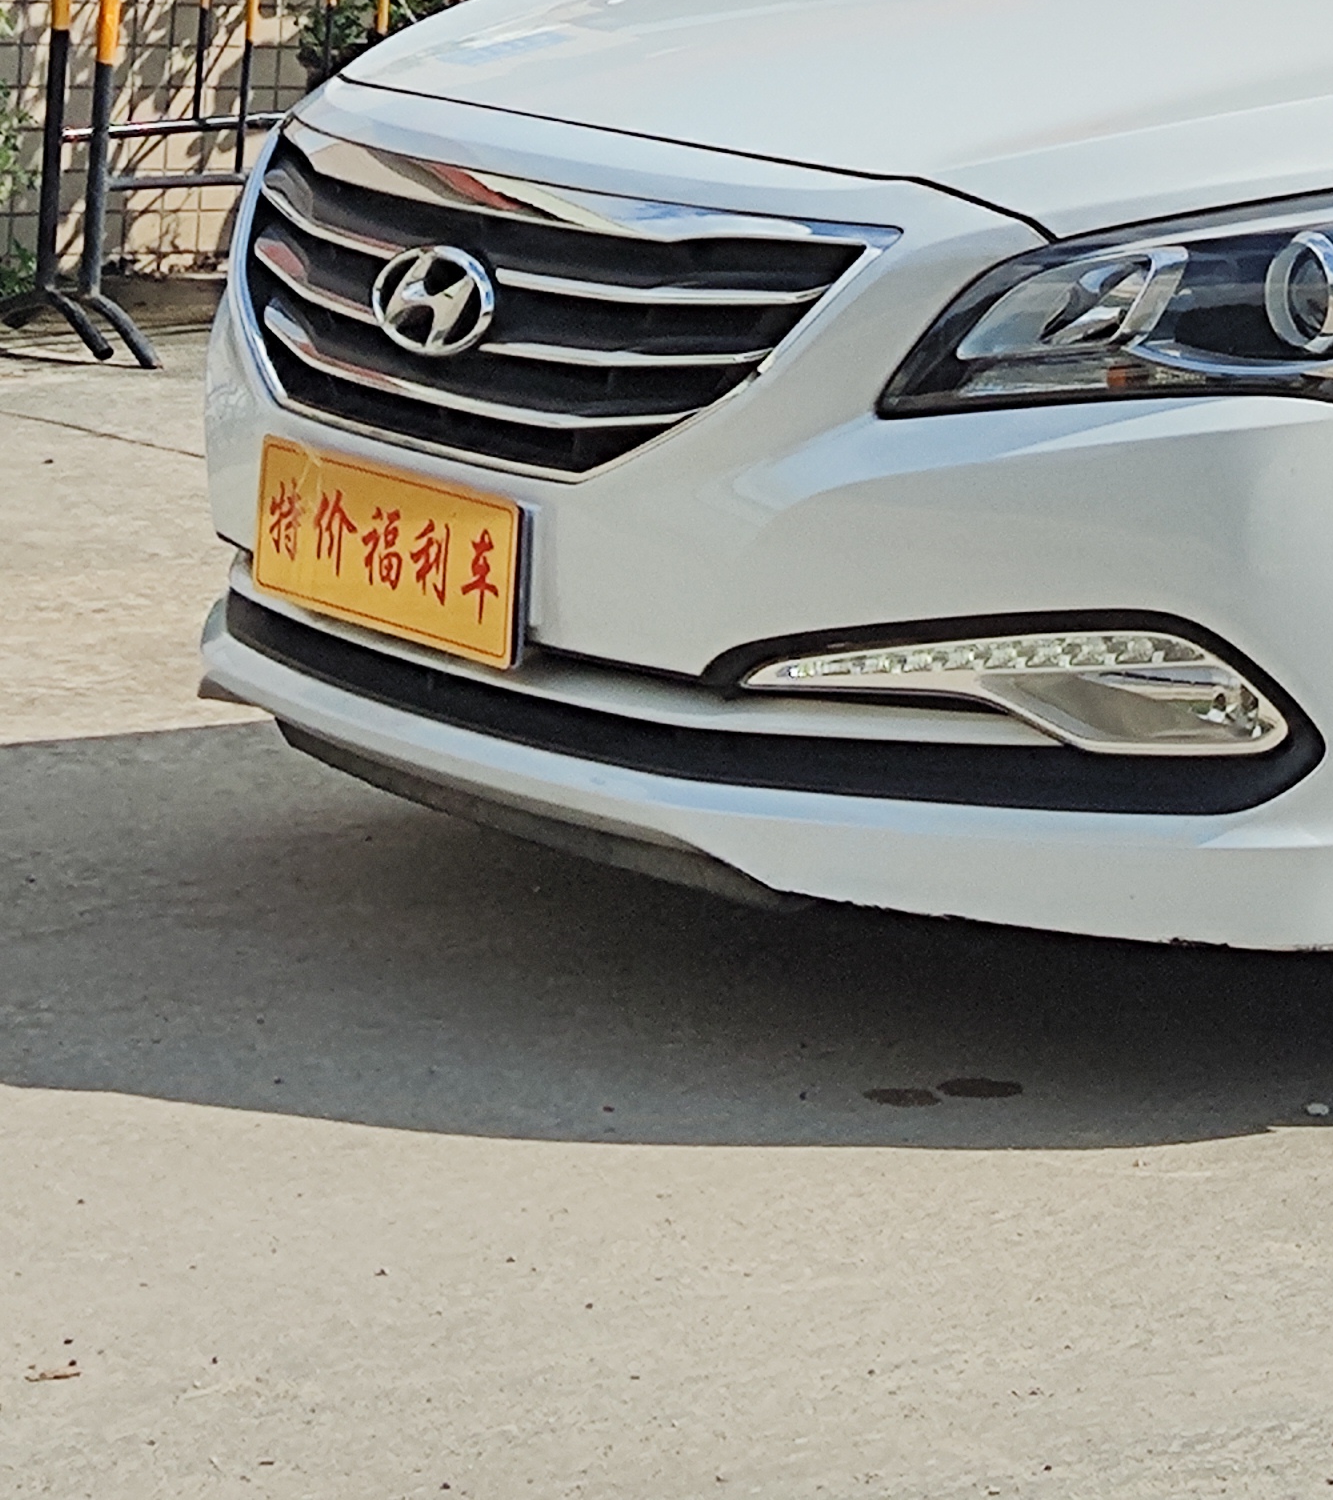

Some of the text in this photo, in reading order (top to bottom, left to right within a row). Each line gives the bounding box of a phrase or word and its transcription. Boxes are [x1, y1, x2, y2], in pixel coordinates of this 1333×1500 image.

[268, 476, 499, 624] 特价福利车
